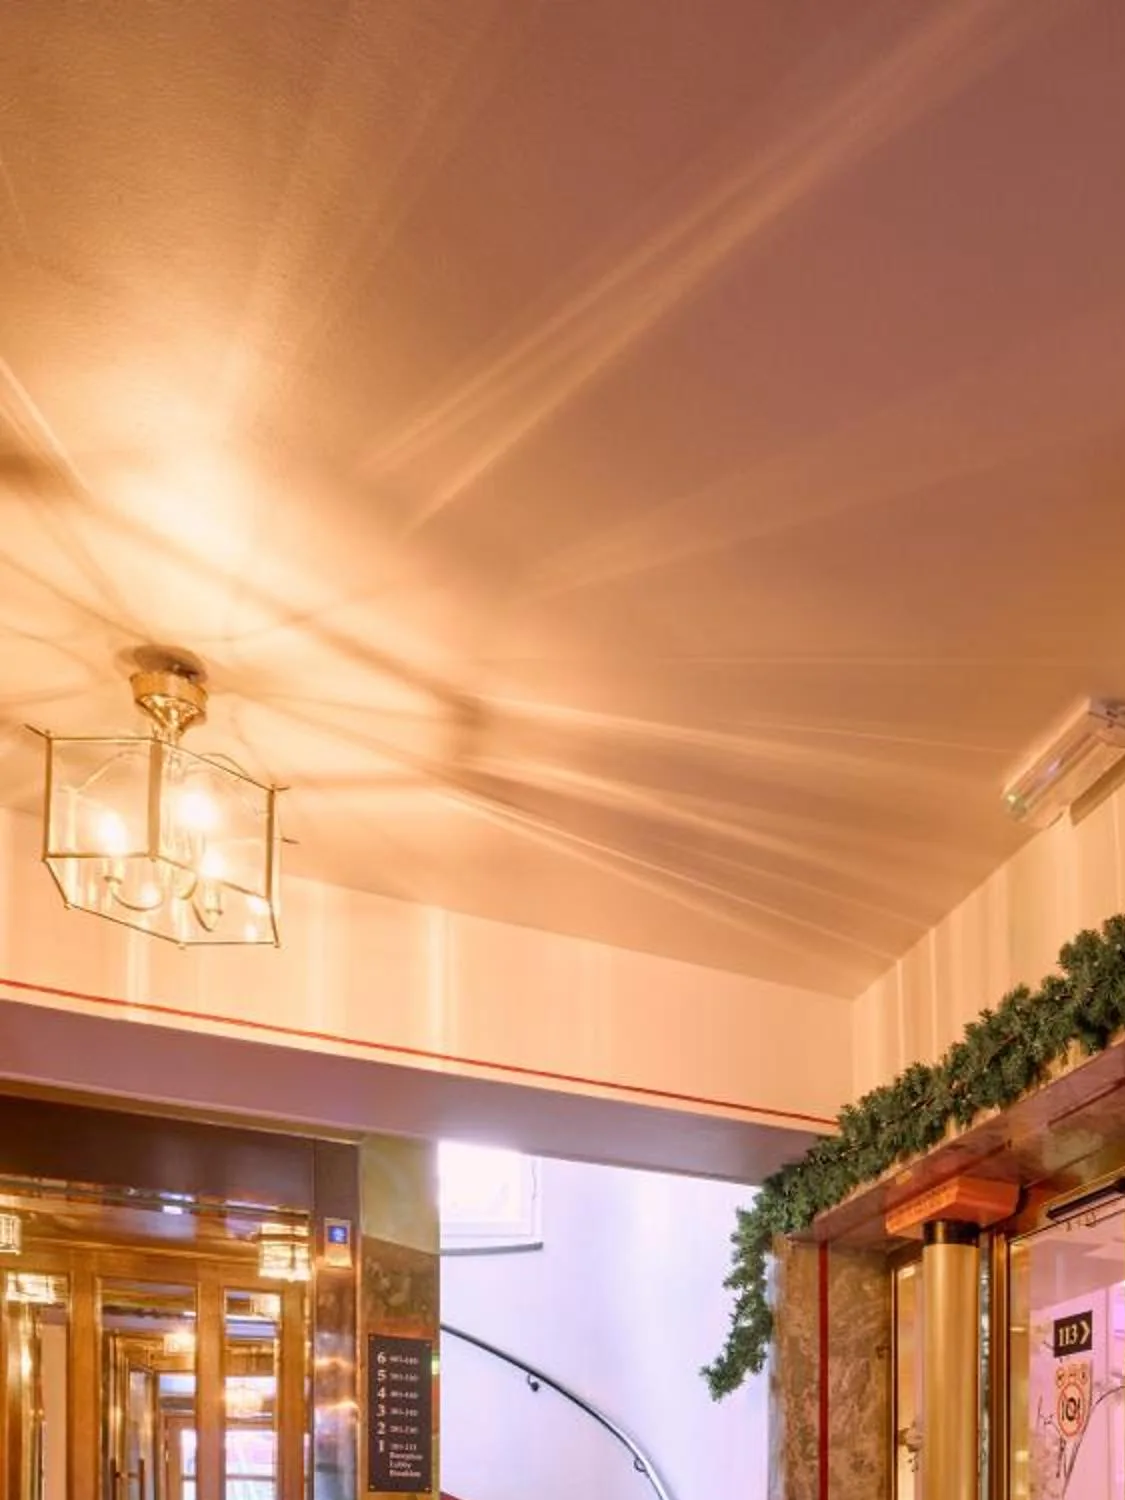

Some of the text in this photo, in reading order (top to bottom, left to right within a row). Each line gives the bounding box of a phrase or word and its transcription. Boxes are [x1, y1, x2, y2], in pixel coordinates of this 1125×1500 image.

[1059, 1323, 1079, 1347] 113
[377, 1352, 387, 1365] 6
[377, 1369, 387, 1381] 5
[376, 1387, 386, 1399] 4
[376, 1404, 386, 1417] 3
[376, 1421, 386, 1435] 2
[379, 1439, 385, 1453] 1
